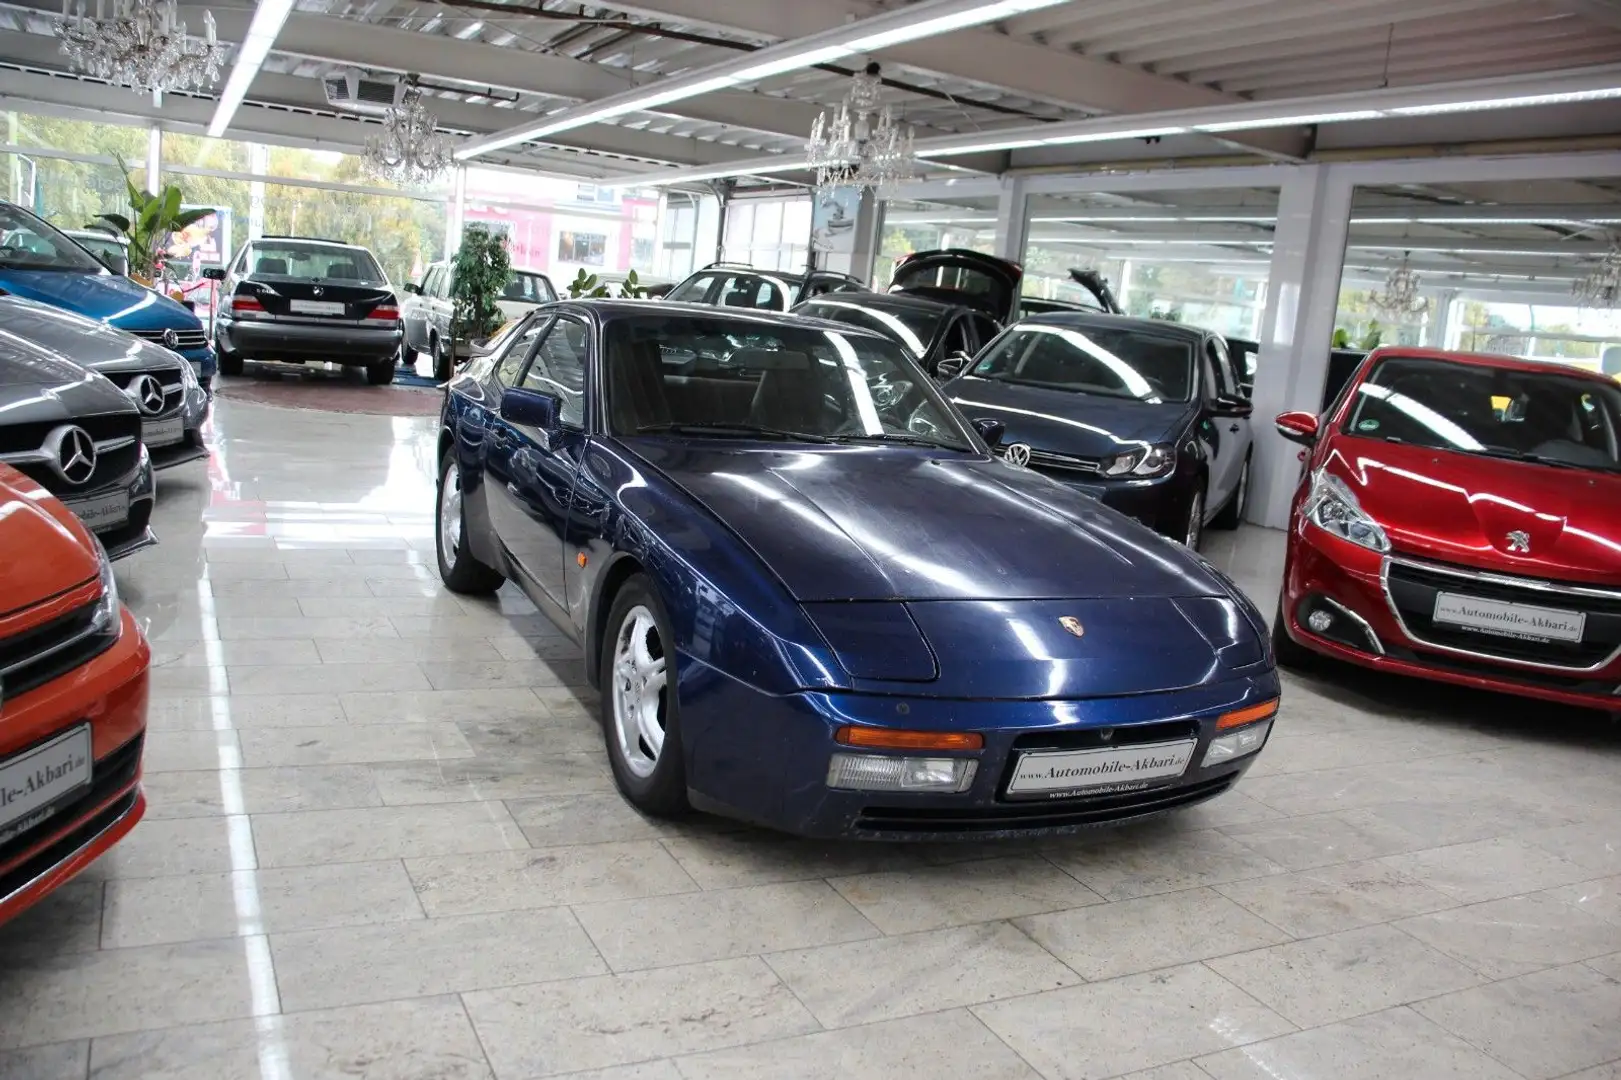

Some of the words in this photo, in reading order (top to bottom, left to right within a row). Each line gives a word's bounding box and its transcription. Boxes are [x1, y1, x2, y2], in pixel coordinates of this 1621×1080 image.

[1440, 606, 1578, 632] www.Automobile-Akbari.de
[1020, 754, 1185, 780] www.Automobile-Akbari.de
[1049, 782, 1149, 799] www.Automobile-Akbari.de
